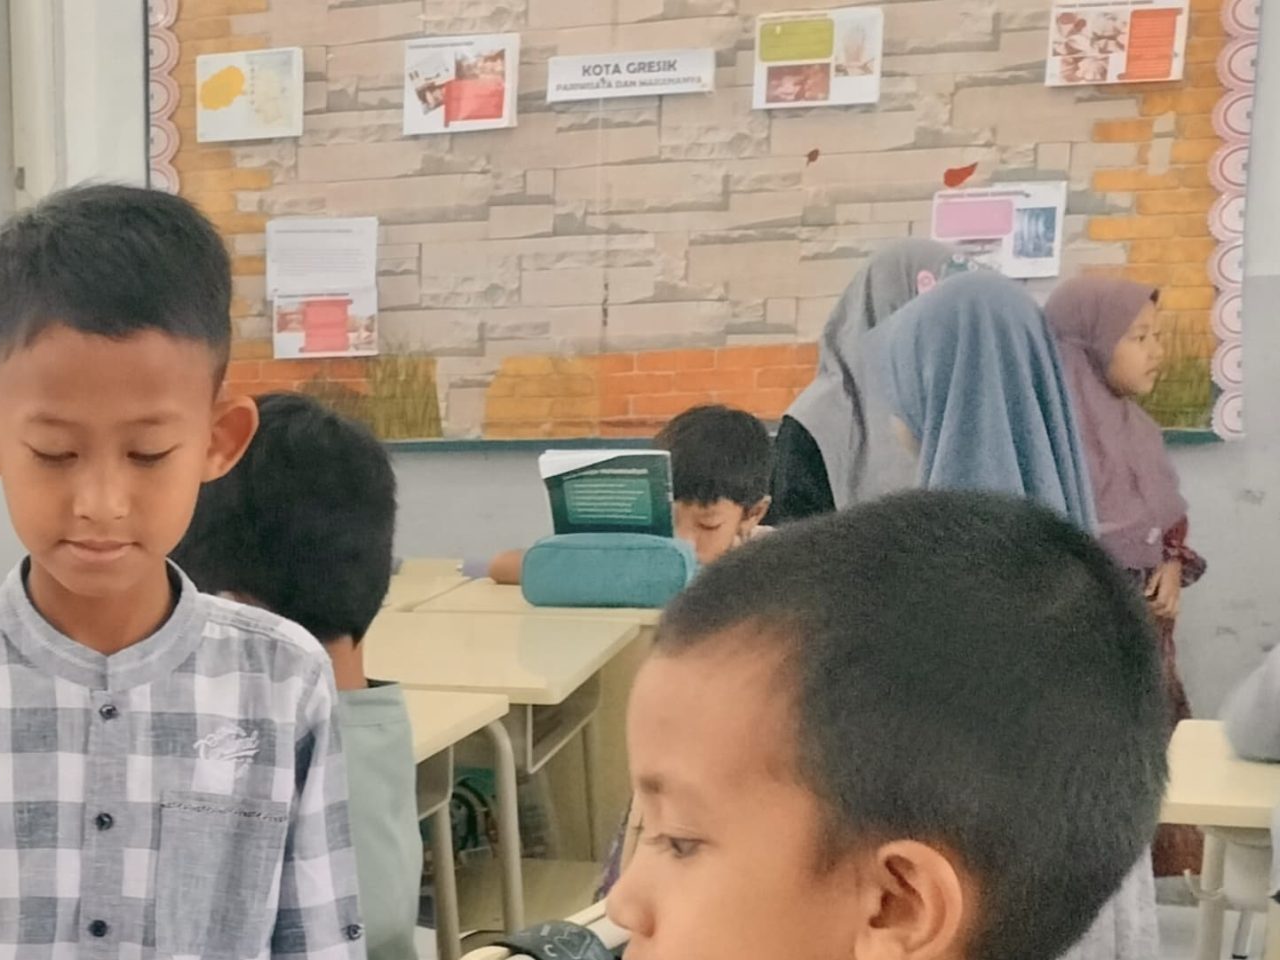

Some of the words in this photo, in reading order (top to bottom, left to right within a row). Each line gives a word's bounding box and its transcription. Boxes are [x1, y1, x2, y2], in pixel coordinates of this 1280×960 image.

[582, 63, 621, 76] KOTA
[626, 59, 677, 74] GRESIK
[615, 80, 637, 88] DAN
